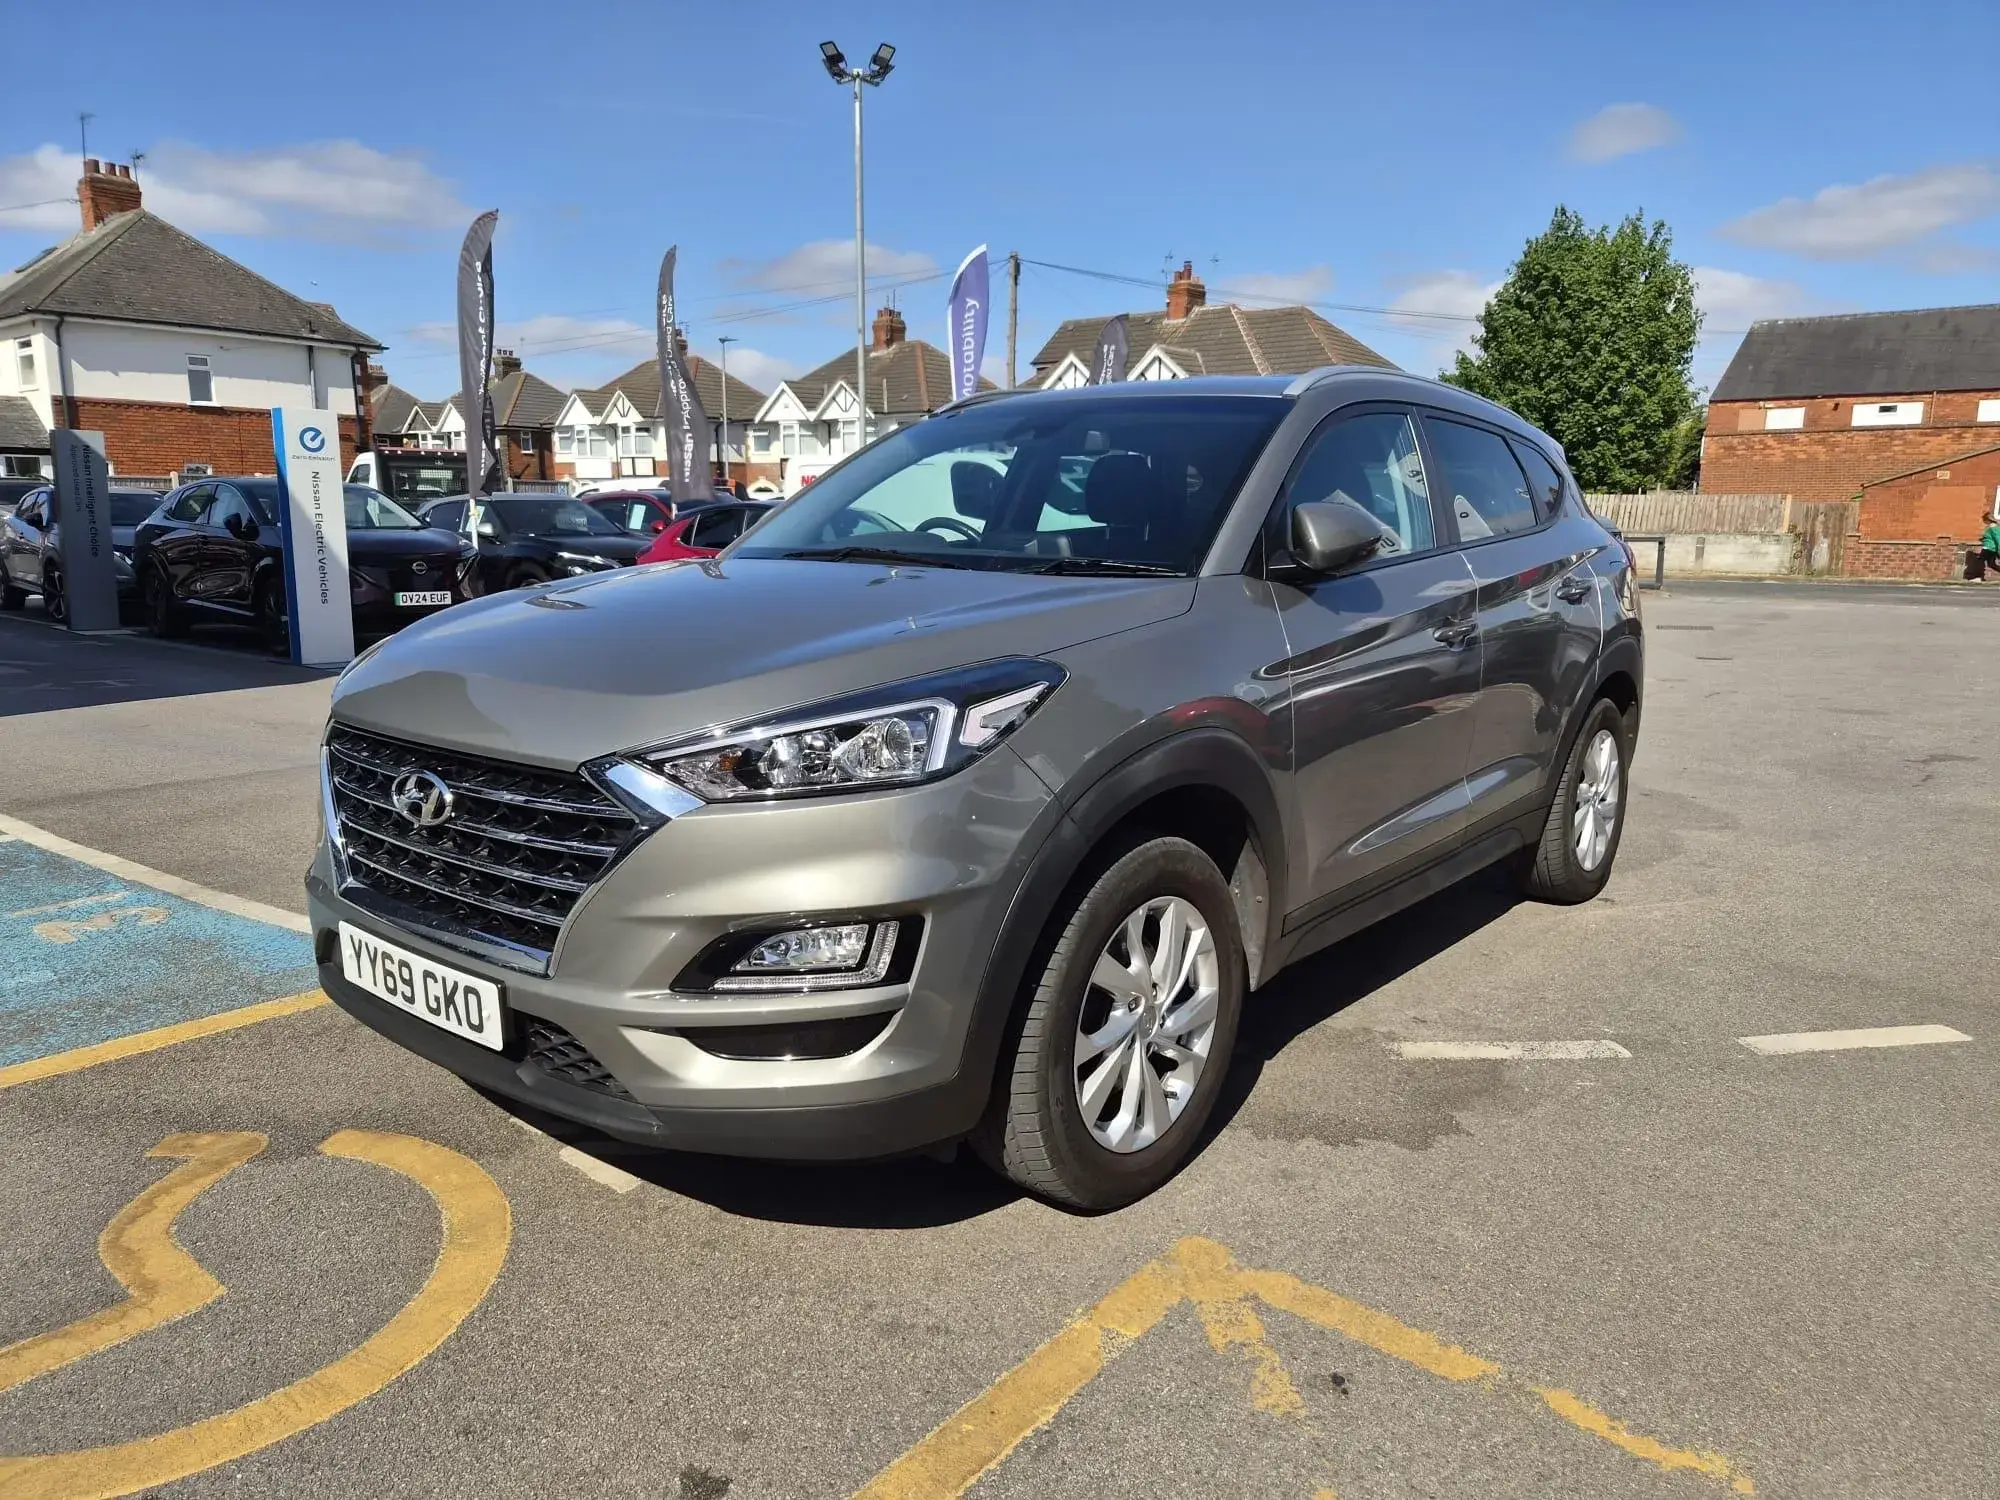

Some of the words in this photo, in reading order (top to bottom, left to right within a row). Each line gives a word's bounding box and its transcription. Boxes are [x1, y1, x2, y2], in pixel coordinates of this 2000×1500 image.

[82, 444, 92, 476] Nissan
[85, 478, 97, 525] Intelligent
[311, 471, 321, 510] Nissan
[89, 526, 101, 558] Choice
[314, 513, 327, 555] Electric
[318, 557, 329, 605] Vehicles
[401, 593, 428, 604] OV24
[430, 592, 449, 603] EUF
[349, 934, 416, 1006] YY69
[422, 968, 485, 1035] GKO
